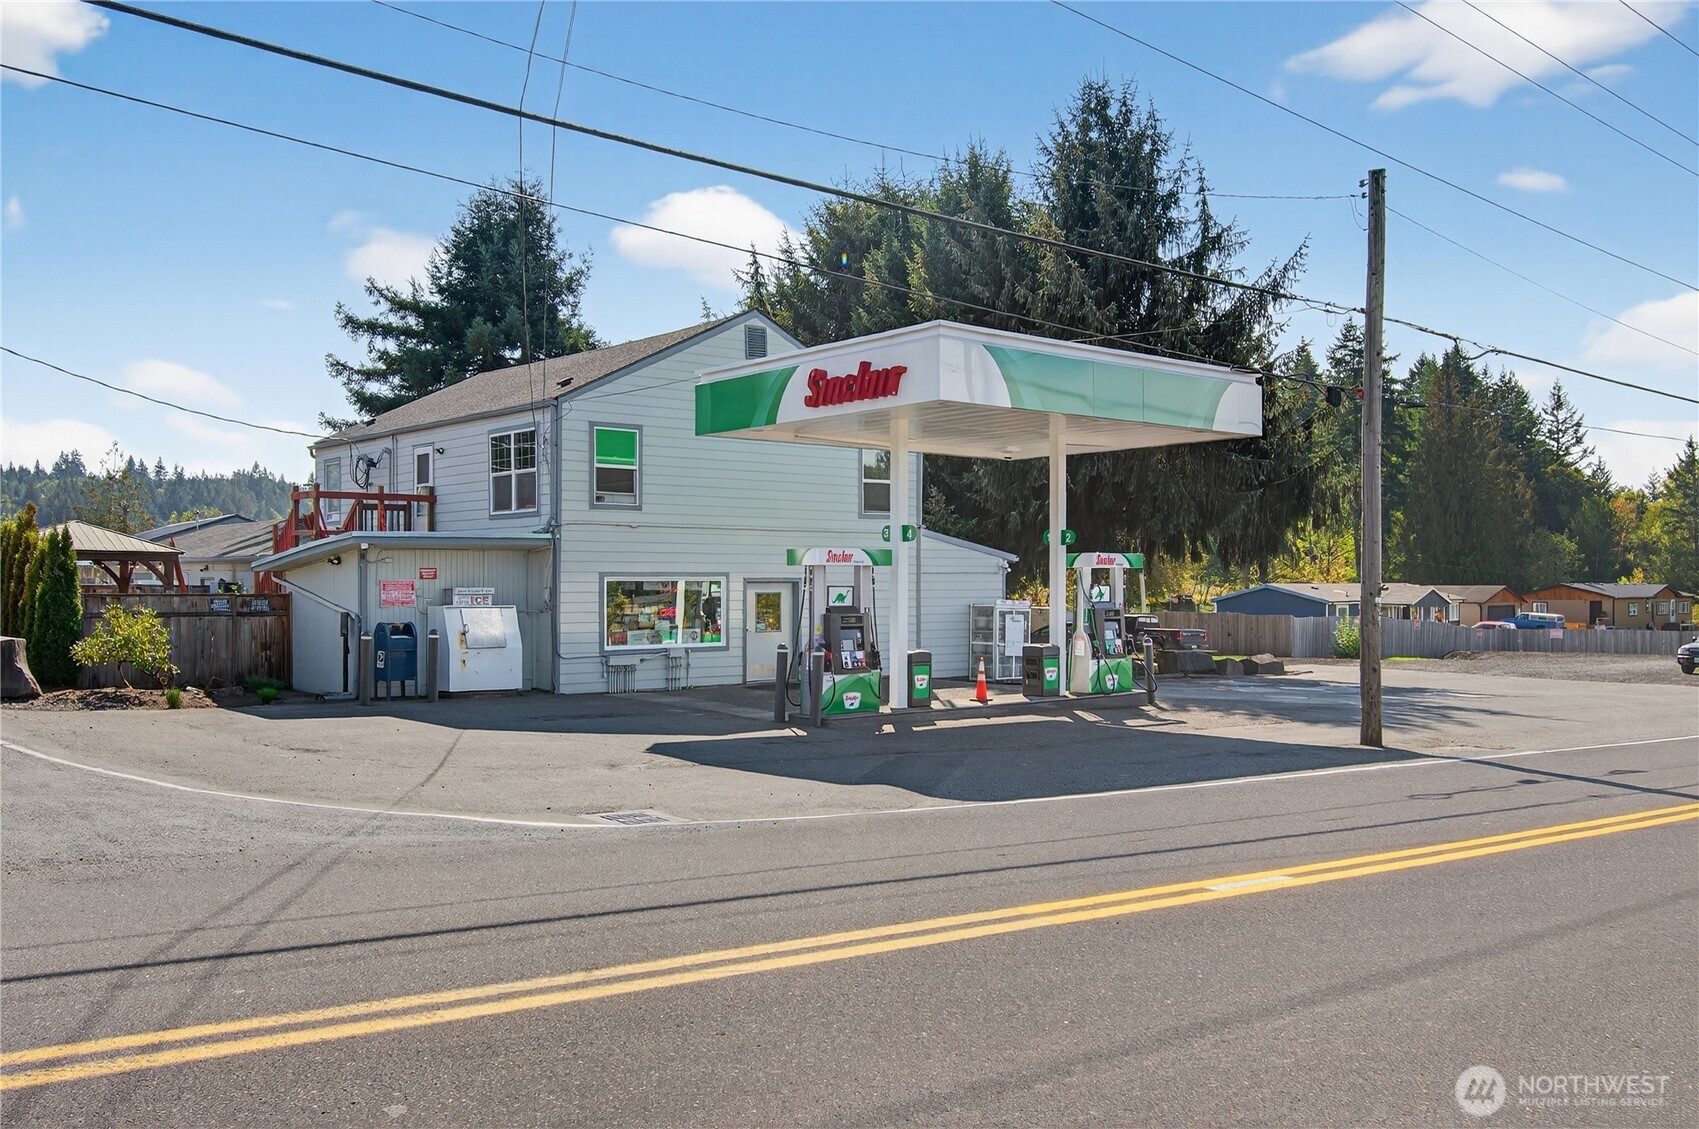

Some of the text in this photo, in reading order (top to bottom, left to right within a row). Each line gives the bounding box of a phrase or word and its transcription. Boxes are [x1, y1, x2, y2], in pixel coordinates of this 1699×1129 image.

[804, 361, 908, 408] Sinclair
[883, 528, 889, 538] 3
[906, 528, 912, 539] 4
[1065, 533, 1071, 543] 2
[470, 596, 490, 605] ICE
